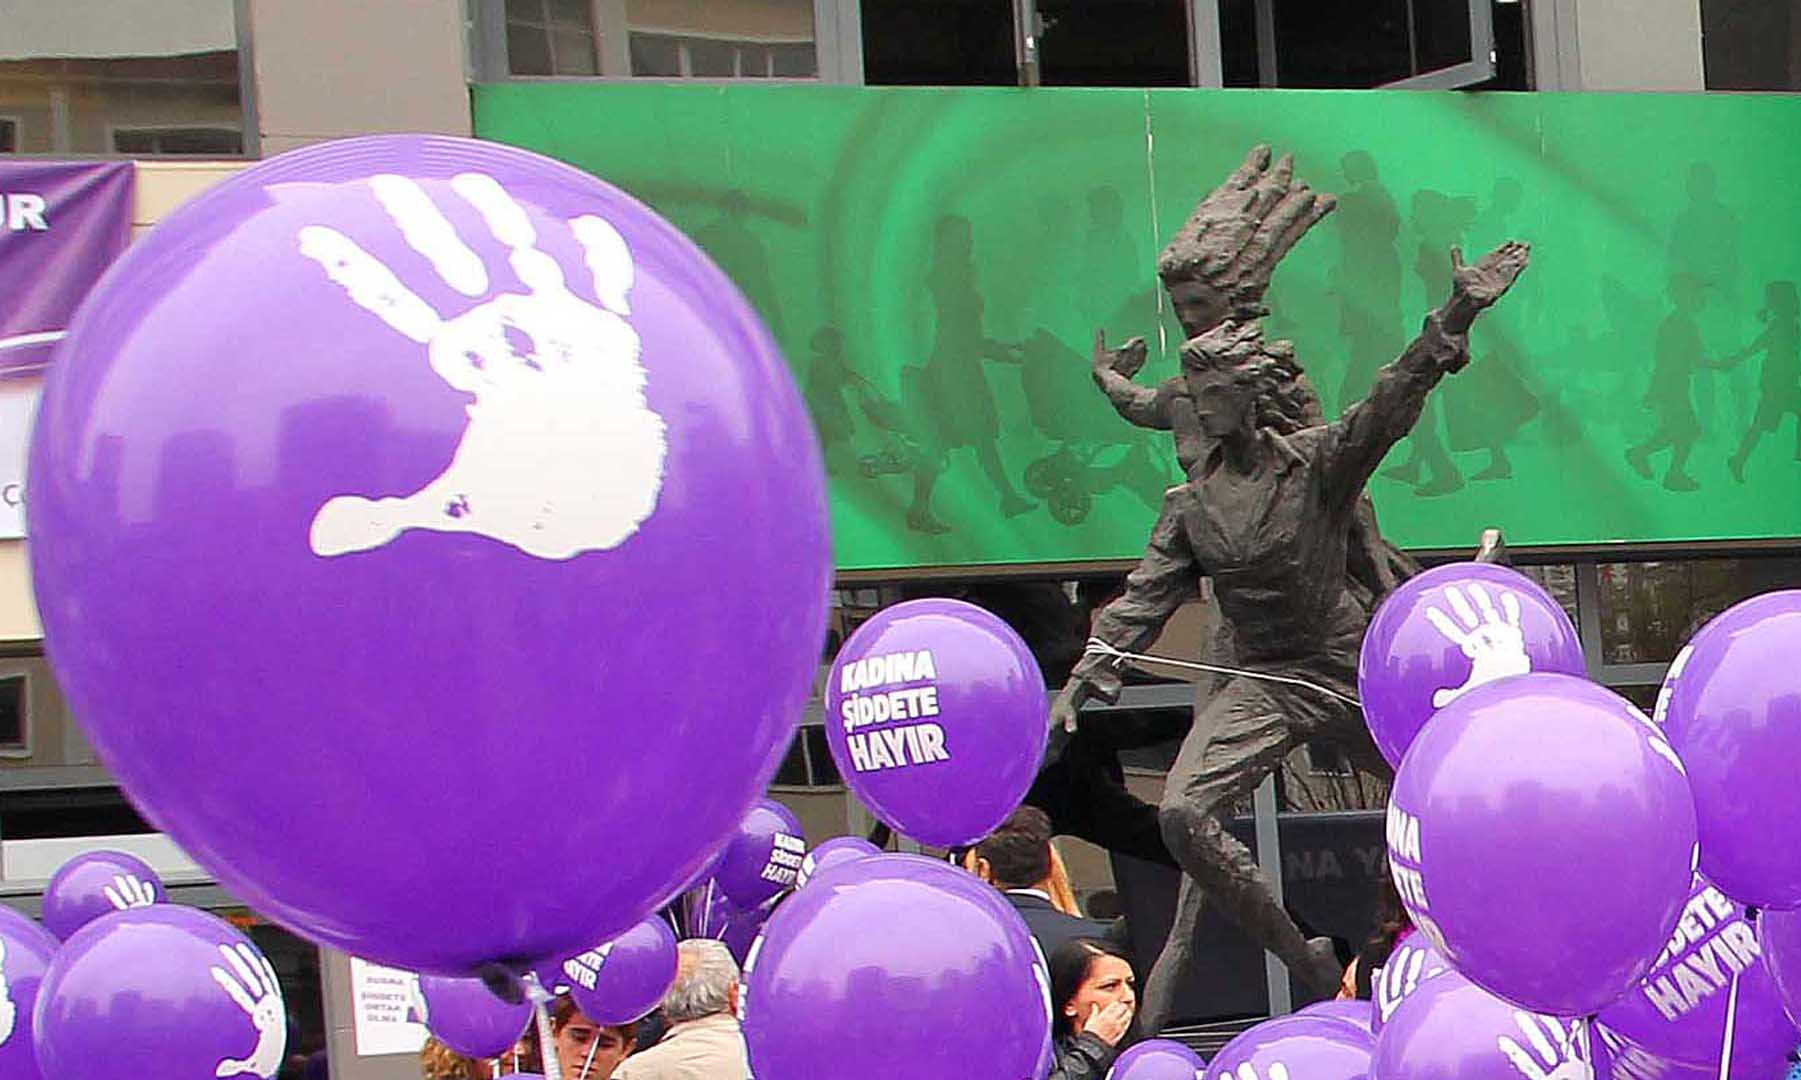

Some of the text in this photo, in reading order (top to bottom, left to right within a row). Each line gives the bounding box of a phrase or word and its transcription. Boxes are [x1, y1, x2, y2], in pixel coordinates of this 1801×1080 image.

[841, 650, 936, 693] KADINA
[842, 686, 939, 733] ŞİDDETE
[846, 723, 951, 771] HAYIR
[1643, 920, 1762, 1022] HAYIR
